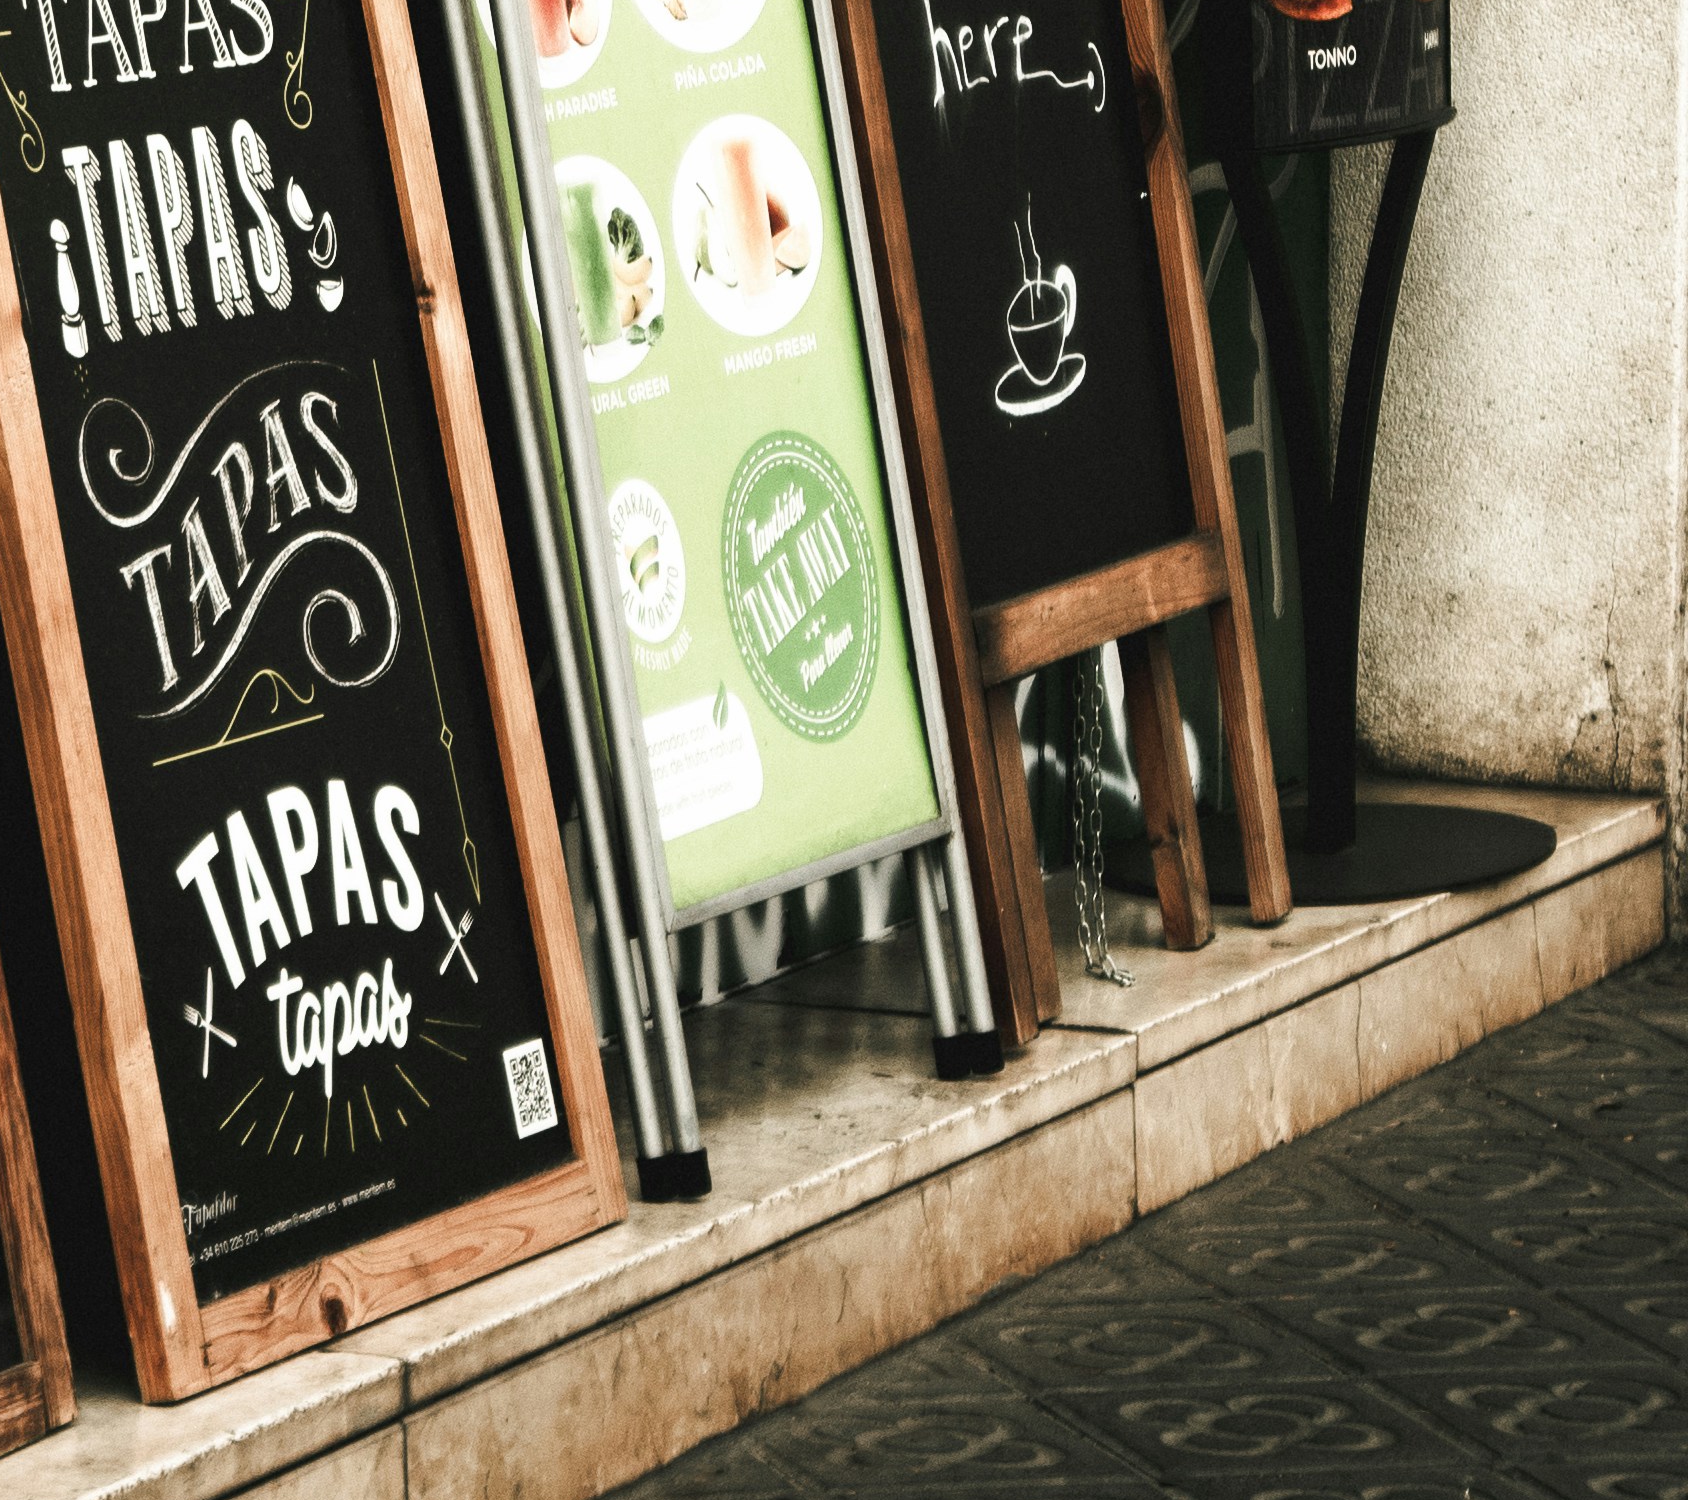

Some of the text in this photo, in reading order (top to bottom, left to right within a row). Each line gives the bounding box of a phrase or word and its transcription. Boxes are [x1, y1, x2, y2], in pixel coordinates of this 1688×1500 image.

[674, 53, 767, 92] PIÑA COLADA
[1308, 45, 1357, 71] TONNO
[555, 87, 618, 120] PARADISE
[62, 118, 292, 342] TAPAS
[724, 333, 818, 376] MANGO FRESH
[627, 374, 670, 405] GREEN
[121, 392, 358, 692] TAPAS
[637, 565, 679, 630] MOMENTO
[743, 503, 851, 656] TAKE AWAY
[176, 779, 425, 991] TAPAS
[267, 957, 411, 1099] tapas
